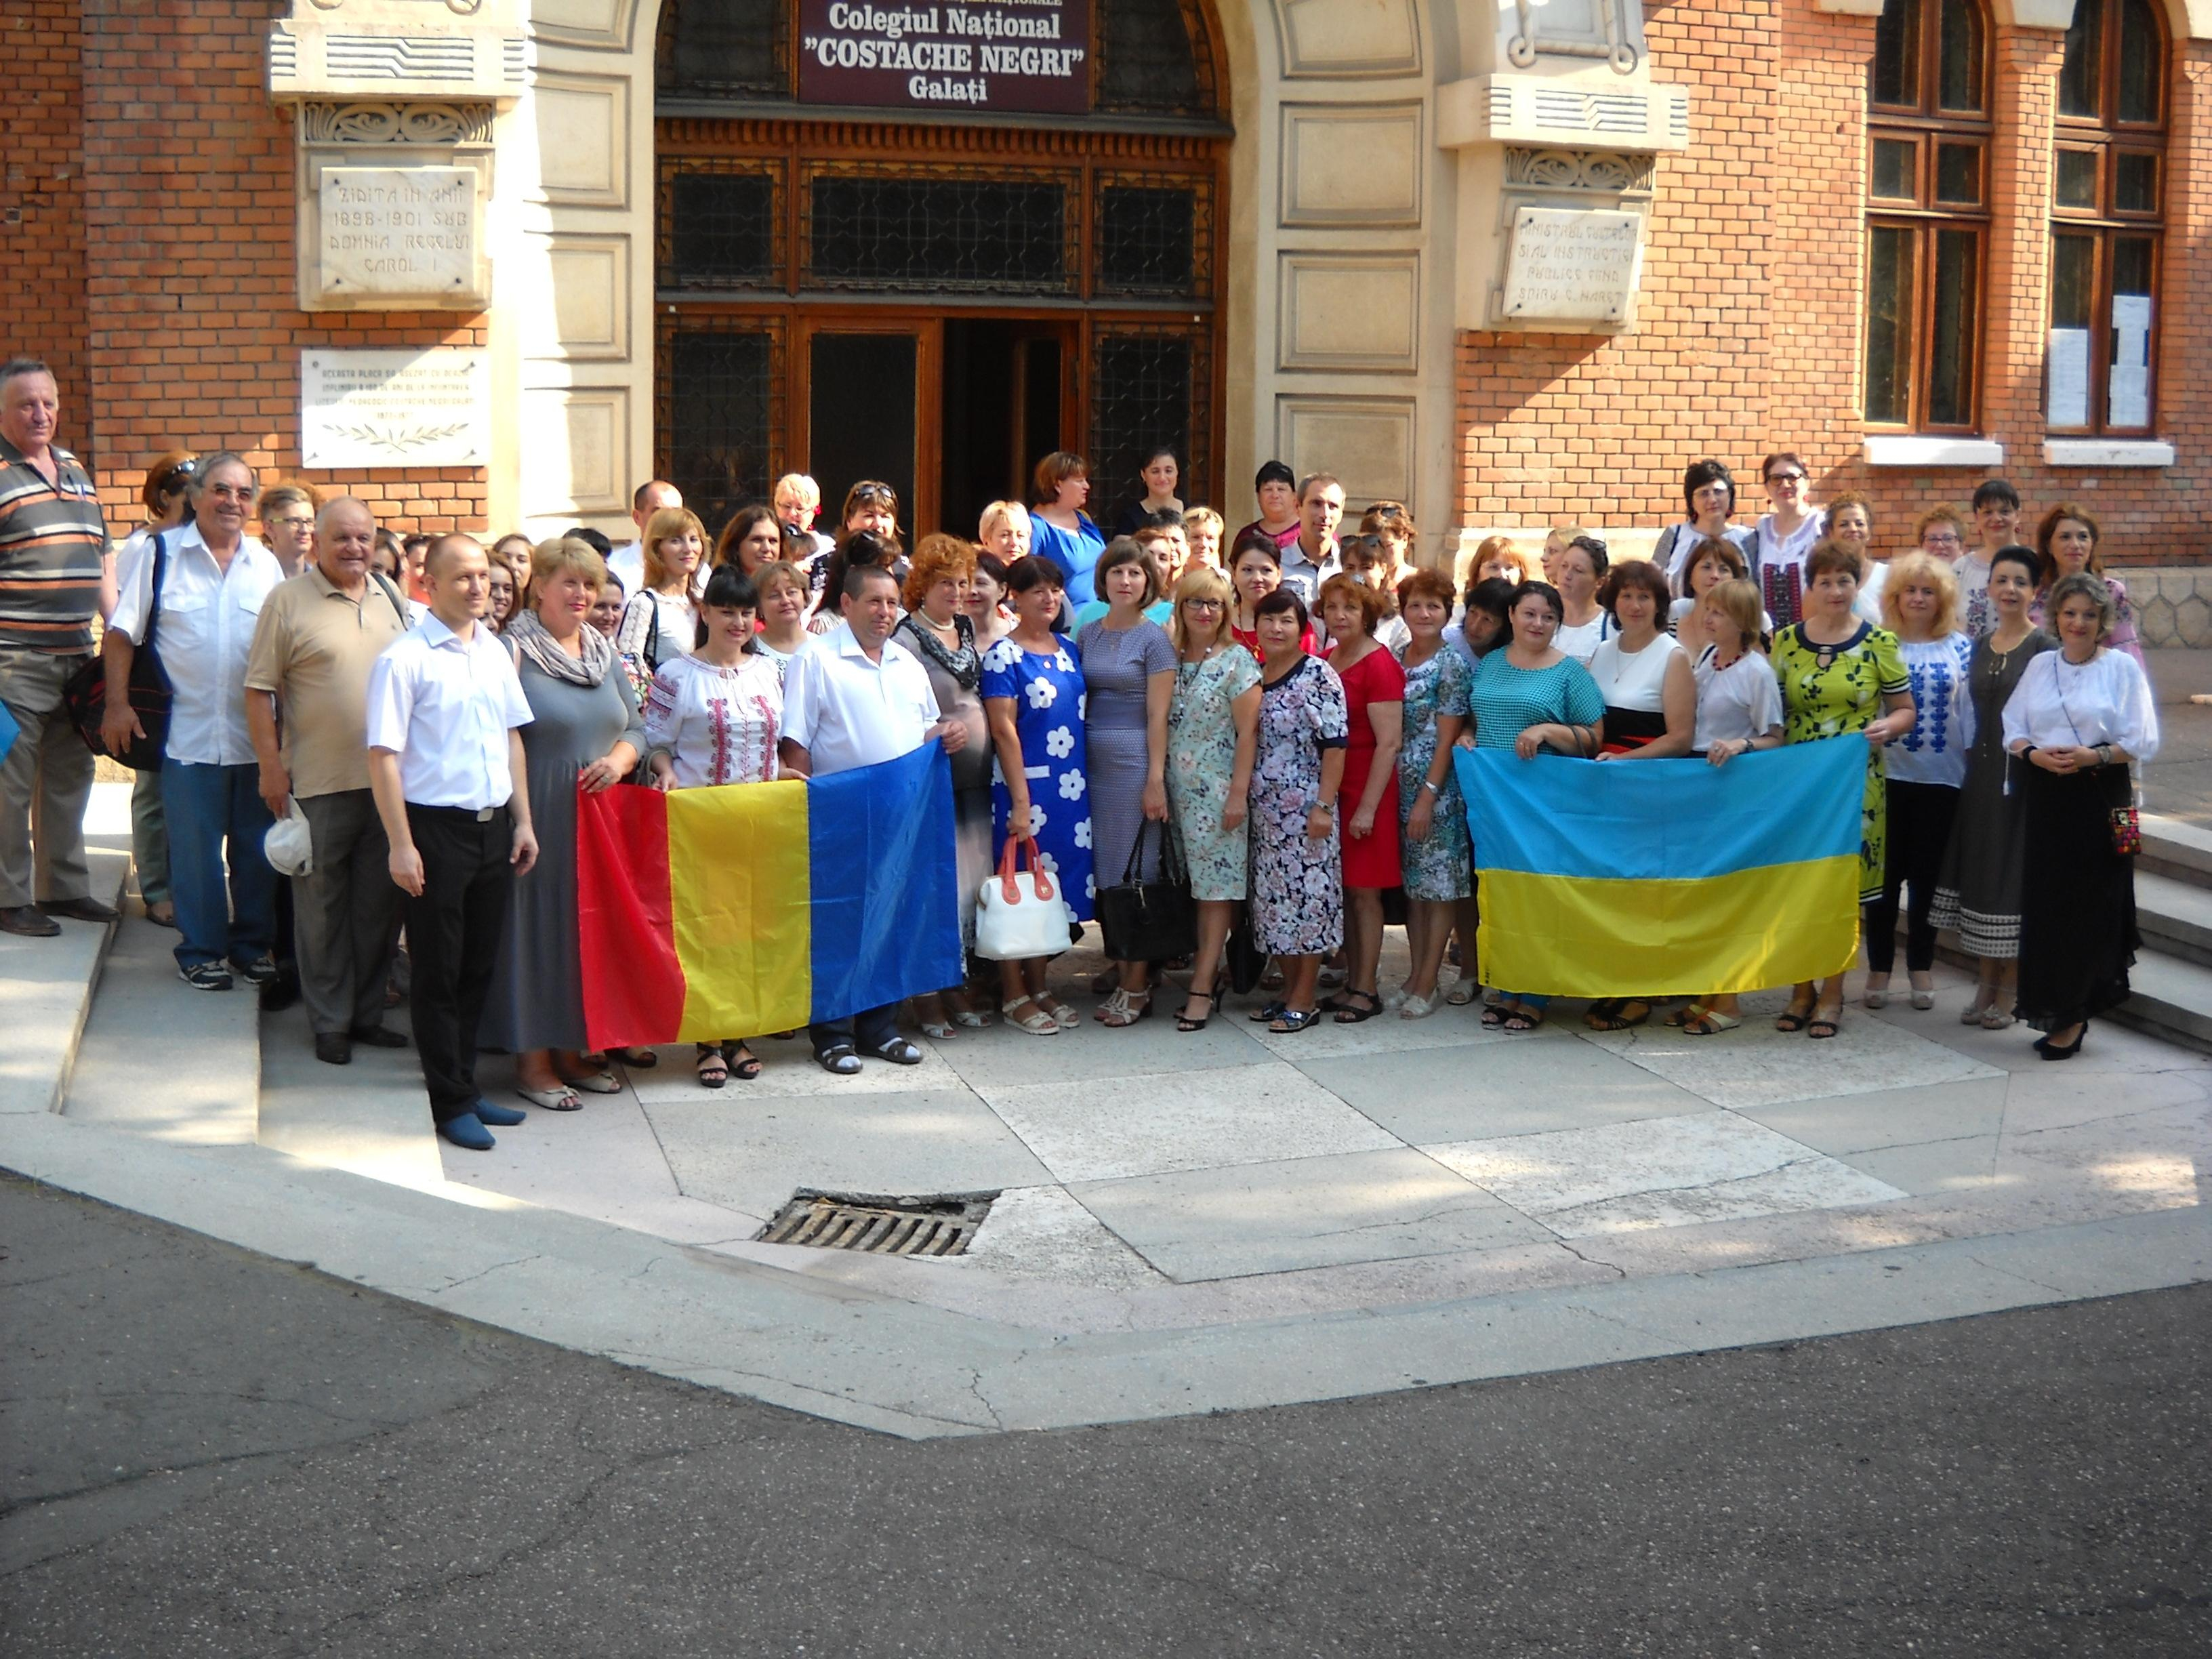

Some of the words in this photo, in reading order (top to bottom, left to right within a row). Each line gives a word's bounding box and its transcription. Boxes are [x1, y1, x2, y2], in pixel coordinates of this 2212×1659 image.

[829, 3, 939, 38] Colegiul
[330, 235, 390, 249] DOMNIA
[364, 258, 415, 272] CAROL
